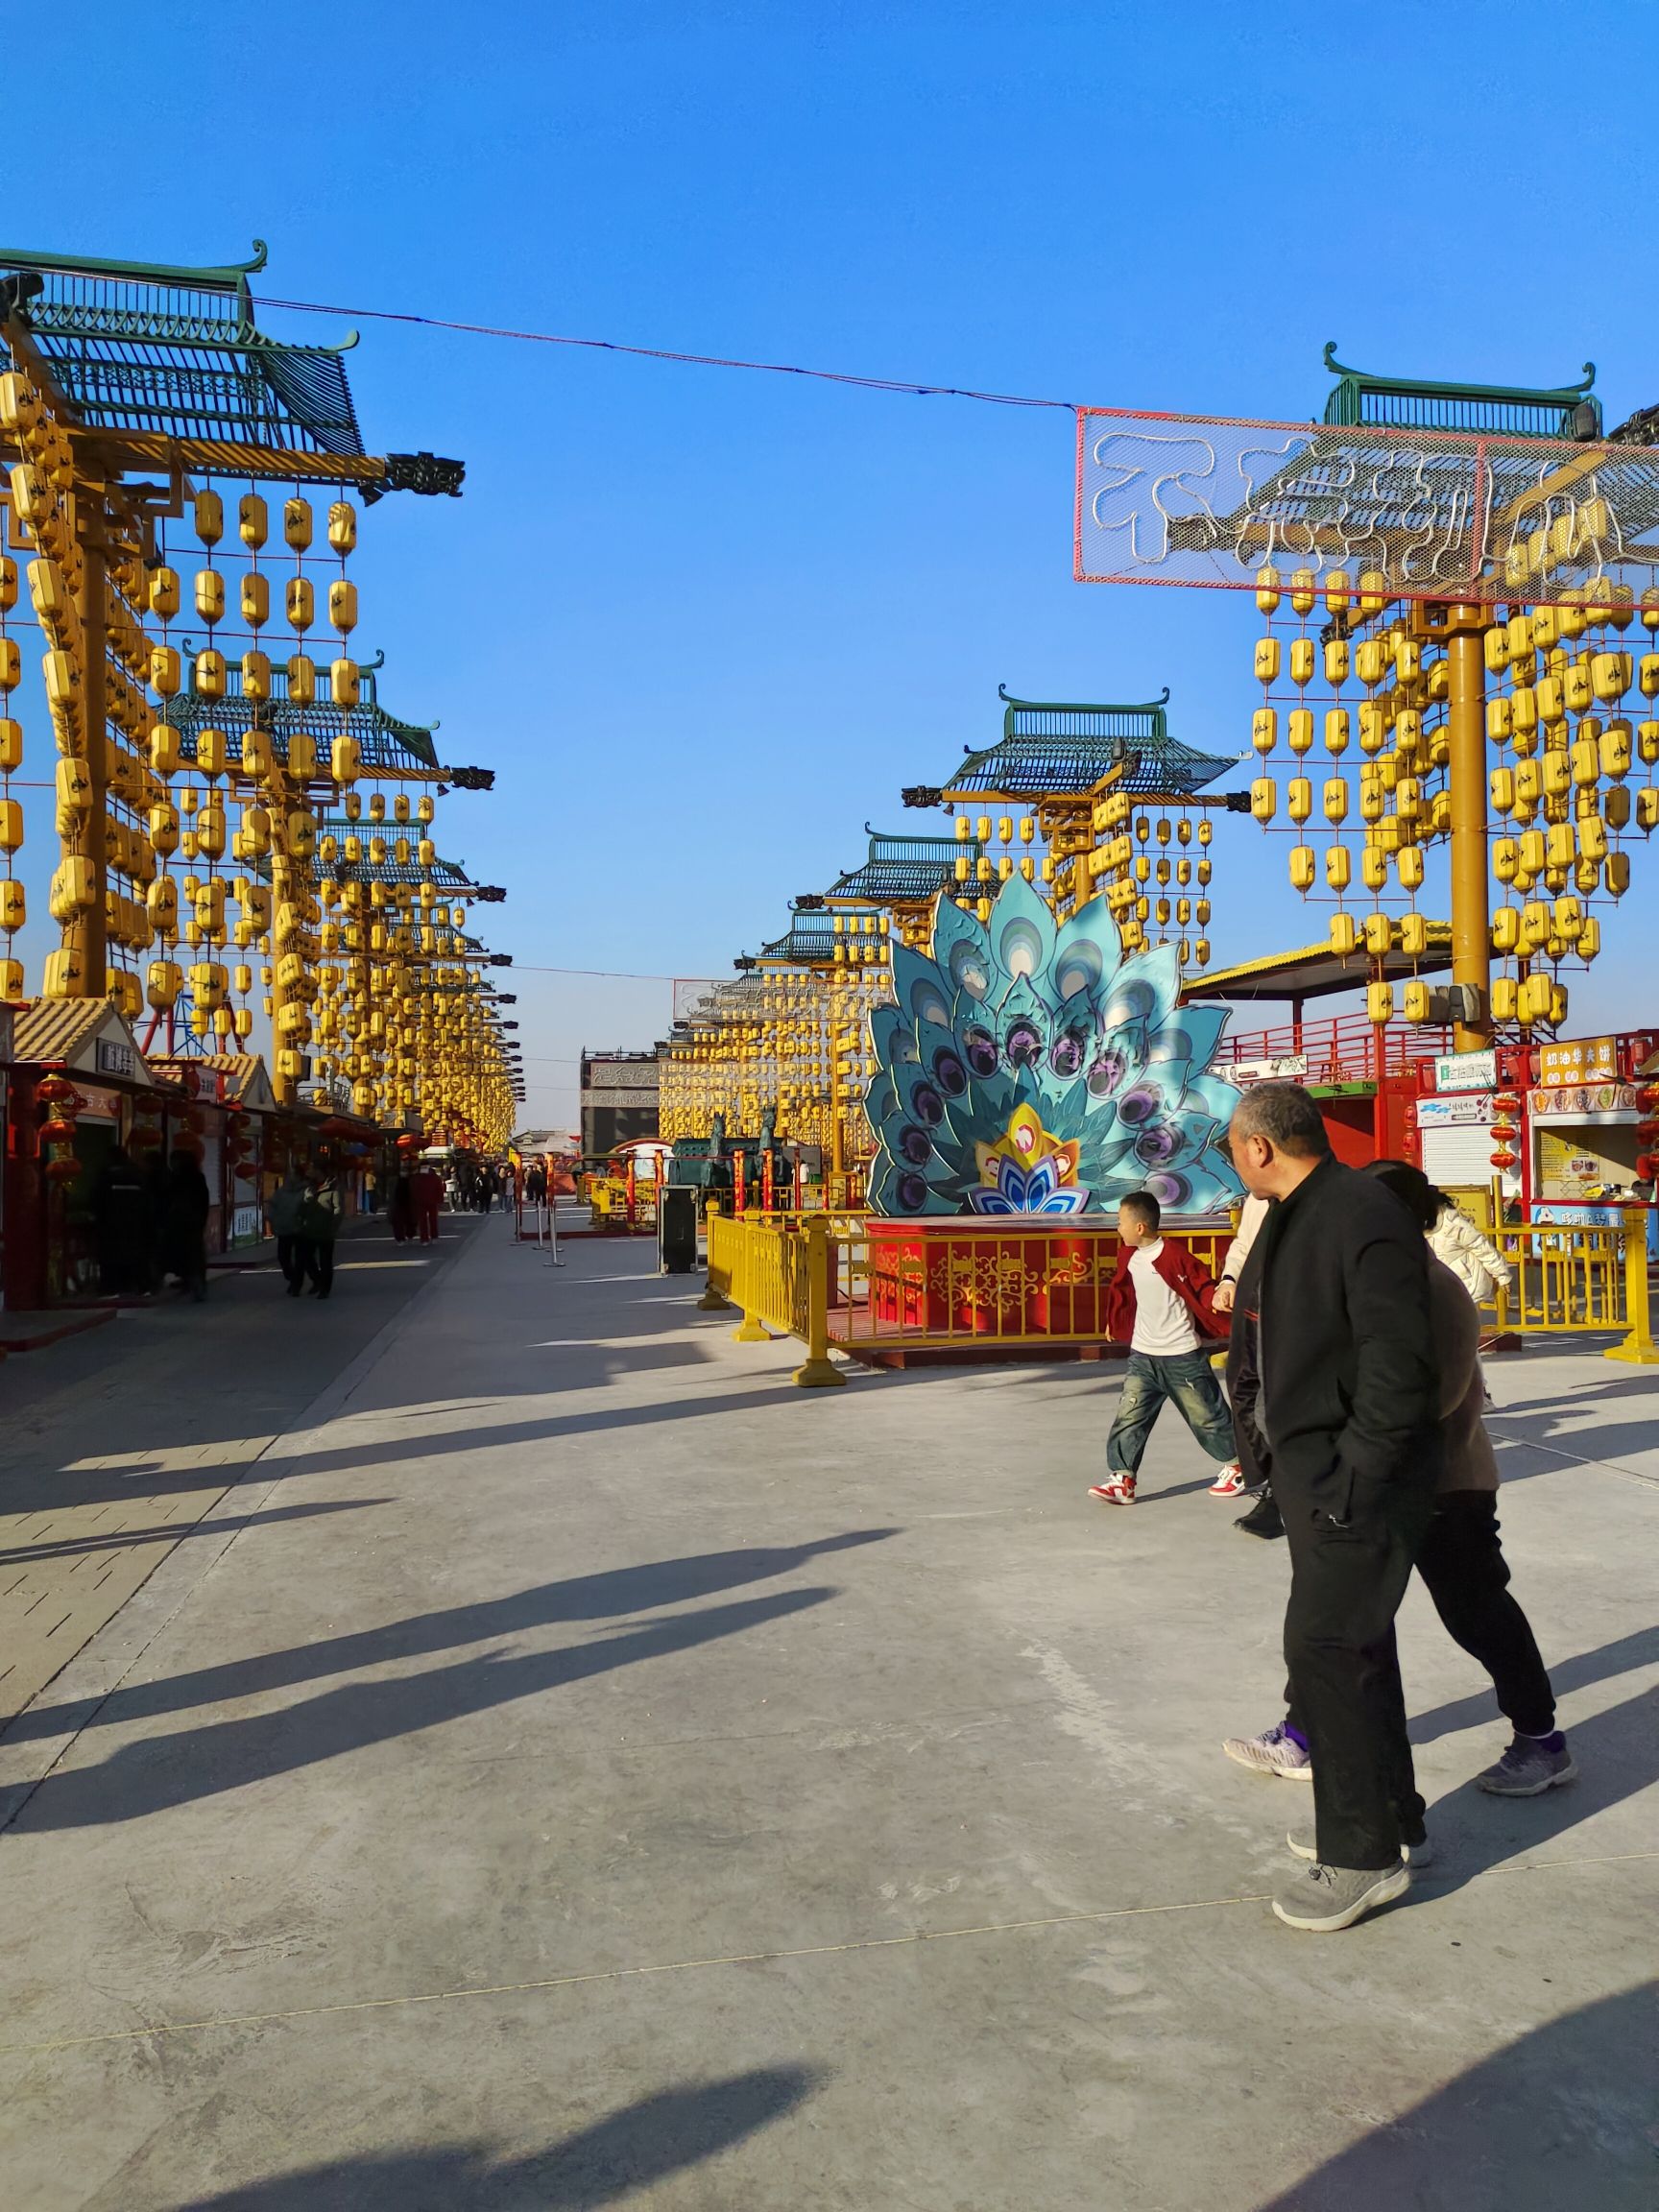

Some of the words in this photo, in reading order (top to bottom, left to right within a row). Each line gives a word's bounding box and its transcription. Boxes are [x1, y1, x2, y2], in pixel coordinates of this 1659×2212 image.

[1546, 1045, 1611, 1067] 奶油华夫饼
